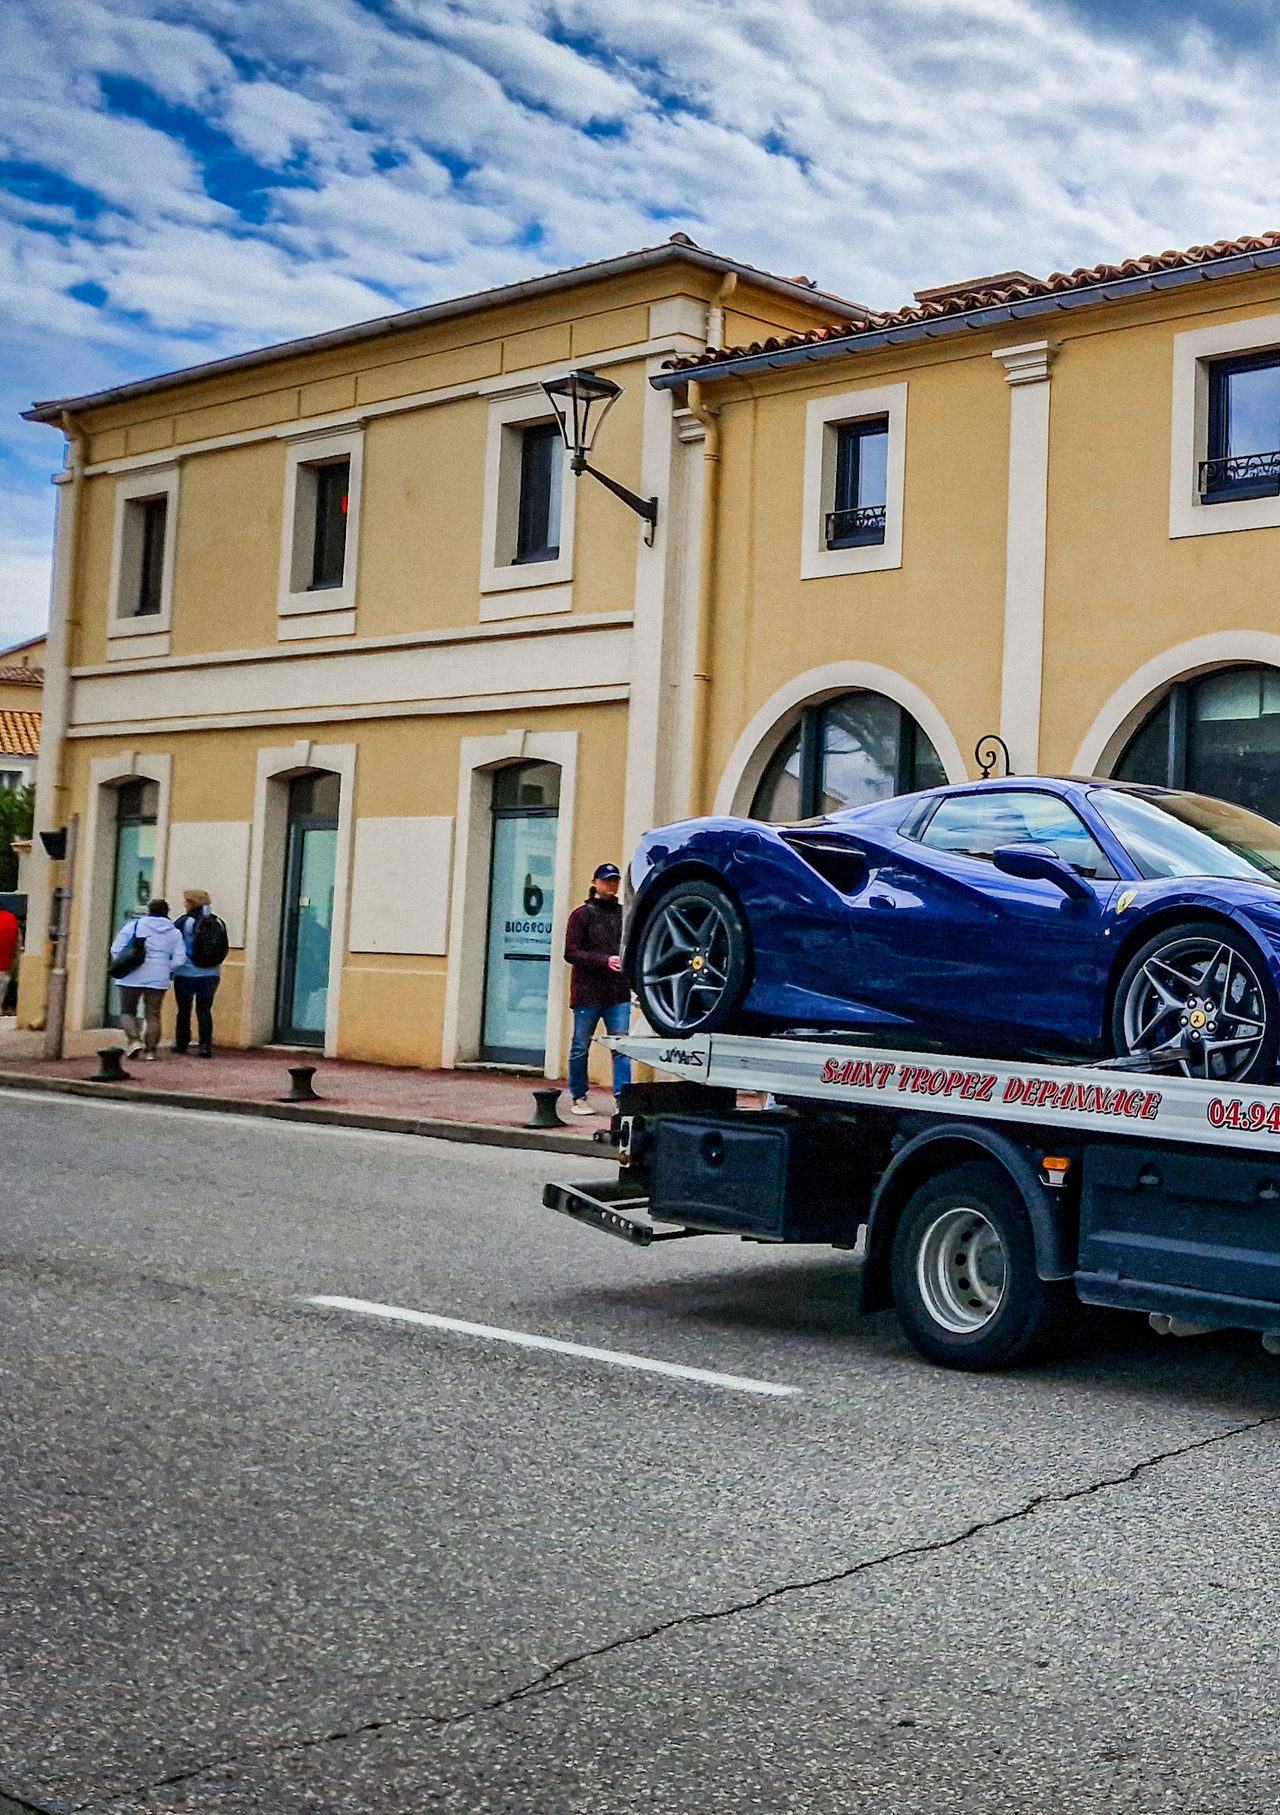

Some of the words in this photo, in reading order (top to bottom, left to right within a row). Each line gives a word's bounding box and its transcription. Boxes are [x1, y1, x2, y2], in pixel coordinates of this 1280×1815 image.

[523, 873, 544, 916] b
[820, 1056, 896, 1088] SAINT
[898, 1065, 998, 1102] TROPEZ
[1002, 1077, 1163, 1119] DEPANNAGE
